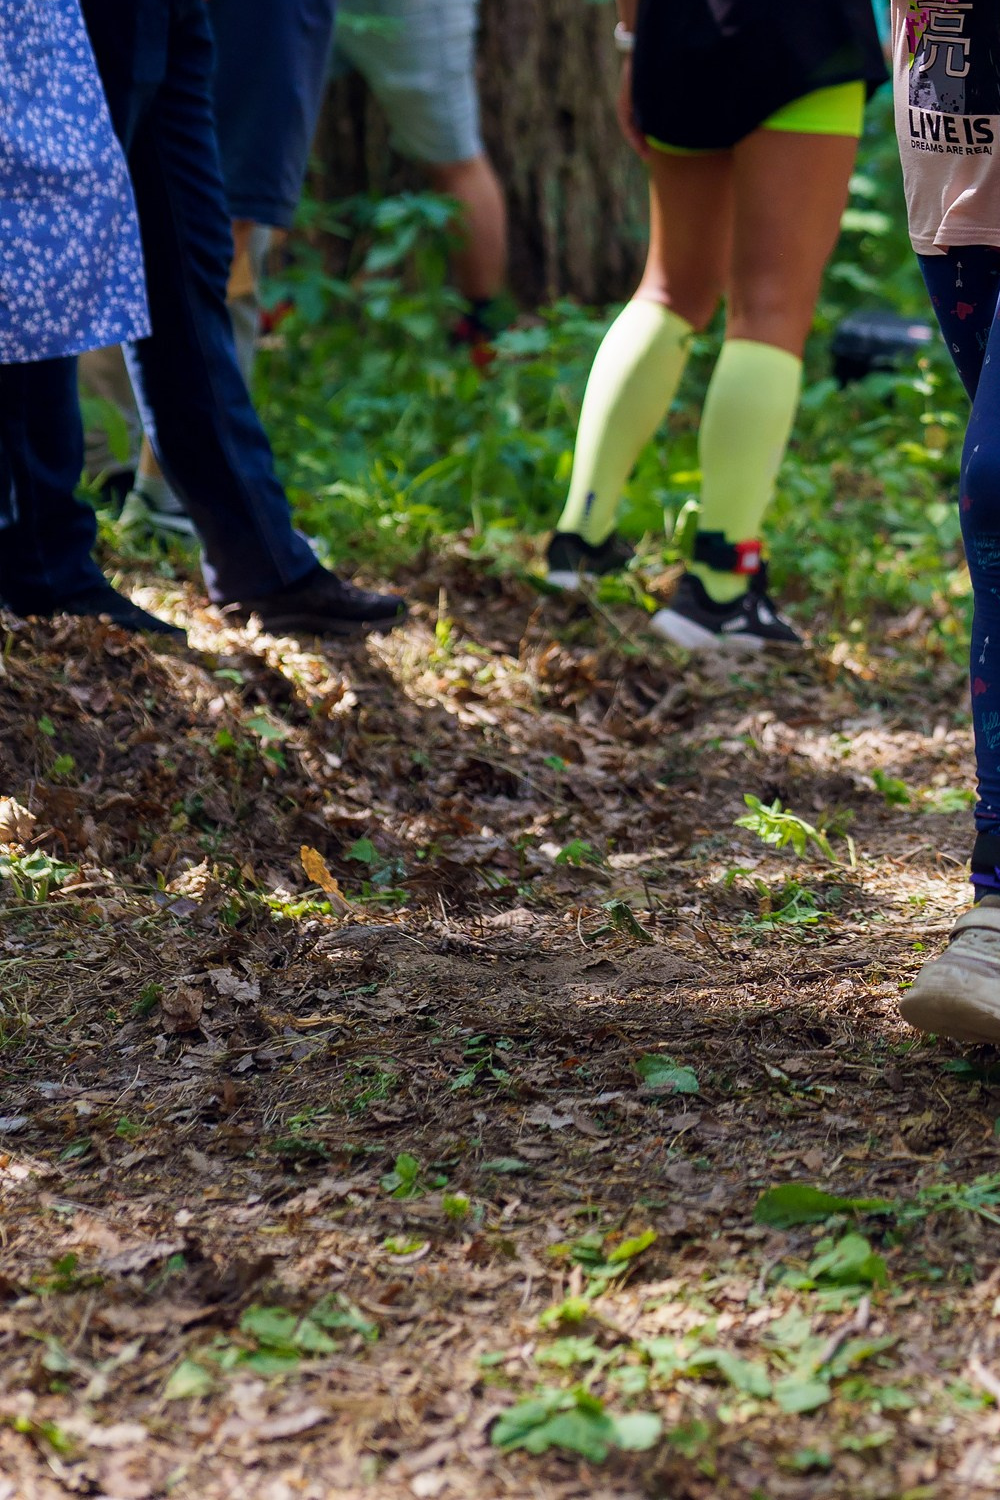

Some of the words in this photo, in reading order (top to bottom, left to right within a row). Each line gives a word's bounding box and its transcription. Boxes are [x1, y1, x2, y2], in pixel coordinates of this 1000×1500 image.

[908, 108, 960, 144] LIVE
[962, 117, 994, 145] IS
[911, 140, 944, 153] DREAMS
[946, 145, 963, 155] ARE
